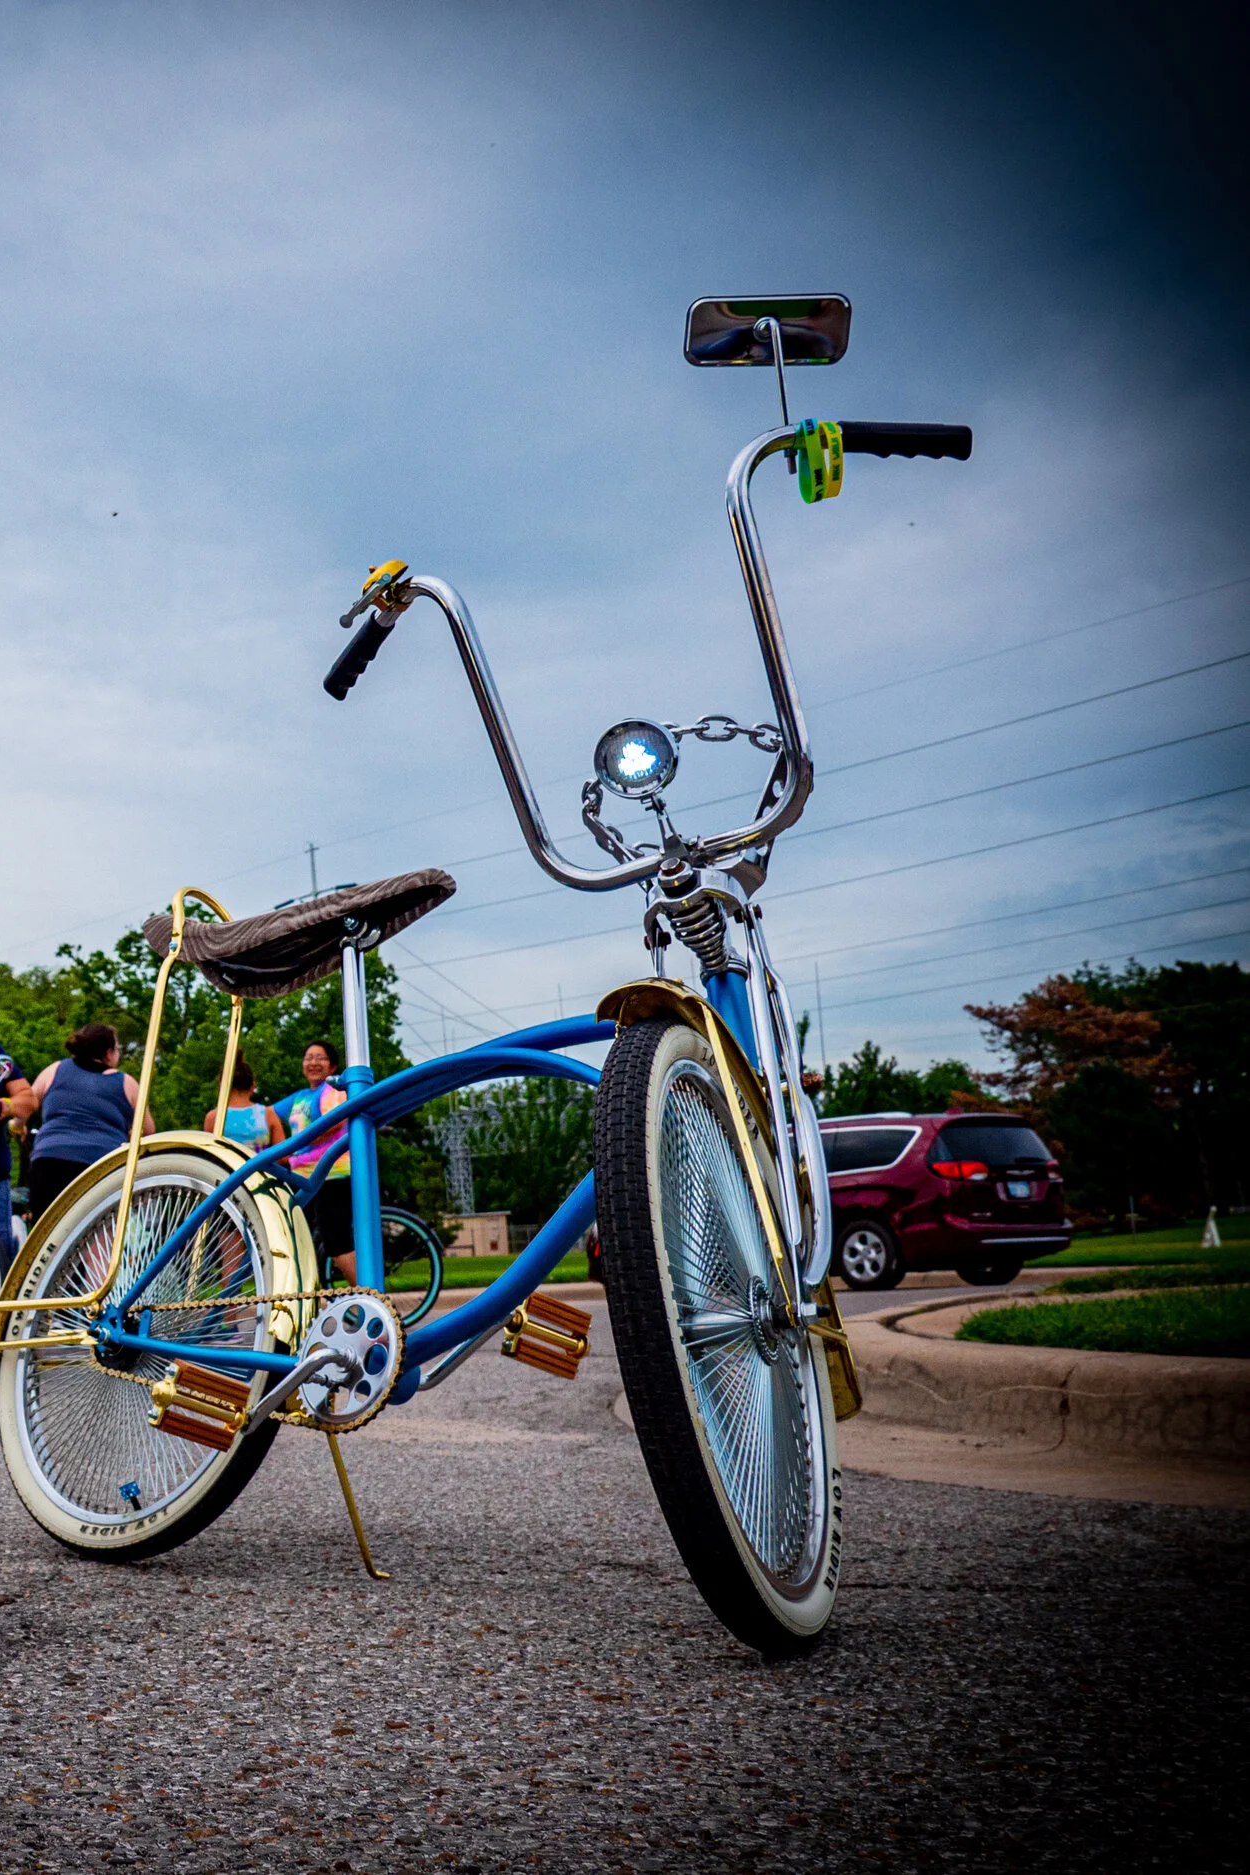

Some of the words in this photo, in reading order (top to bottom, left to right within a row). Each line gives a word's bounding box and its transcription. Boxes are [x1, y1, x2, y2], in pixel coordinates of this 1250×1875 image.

[22, 1242, 58, 1300] RIDER
[134, 1507, 169, 1531] LOW
[831, 1467, 843, 1523] LOW
[79, 1524, 129, 1537] RIDER
[823, 1529, 842, 1593] RIDER
